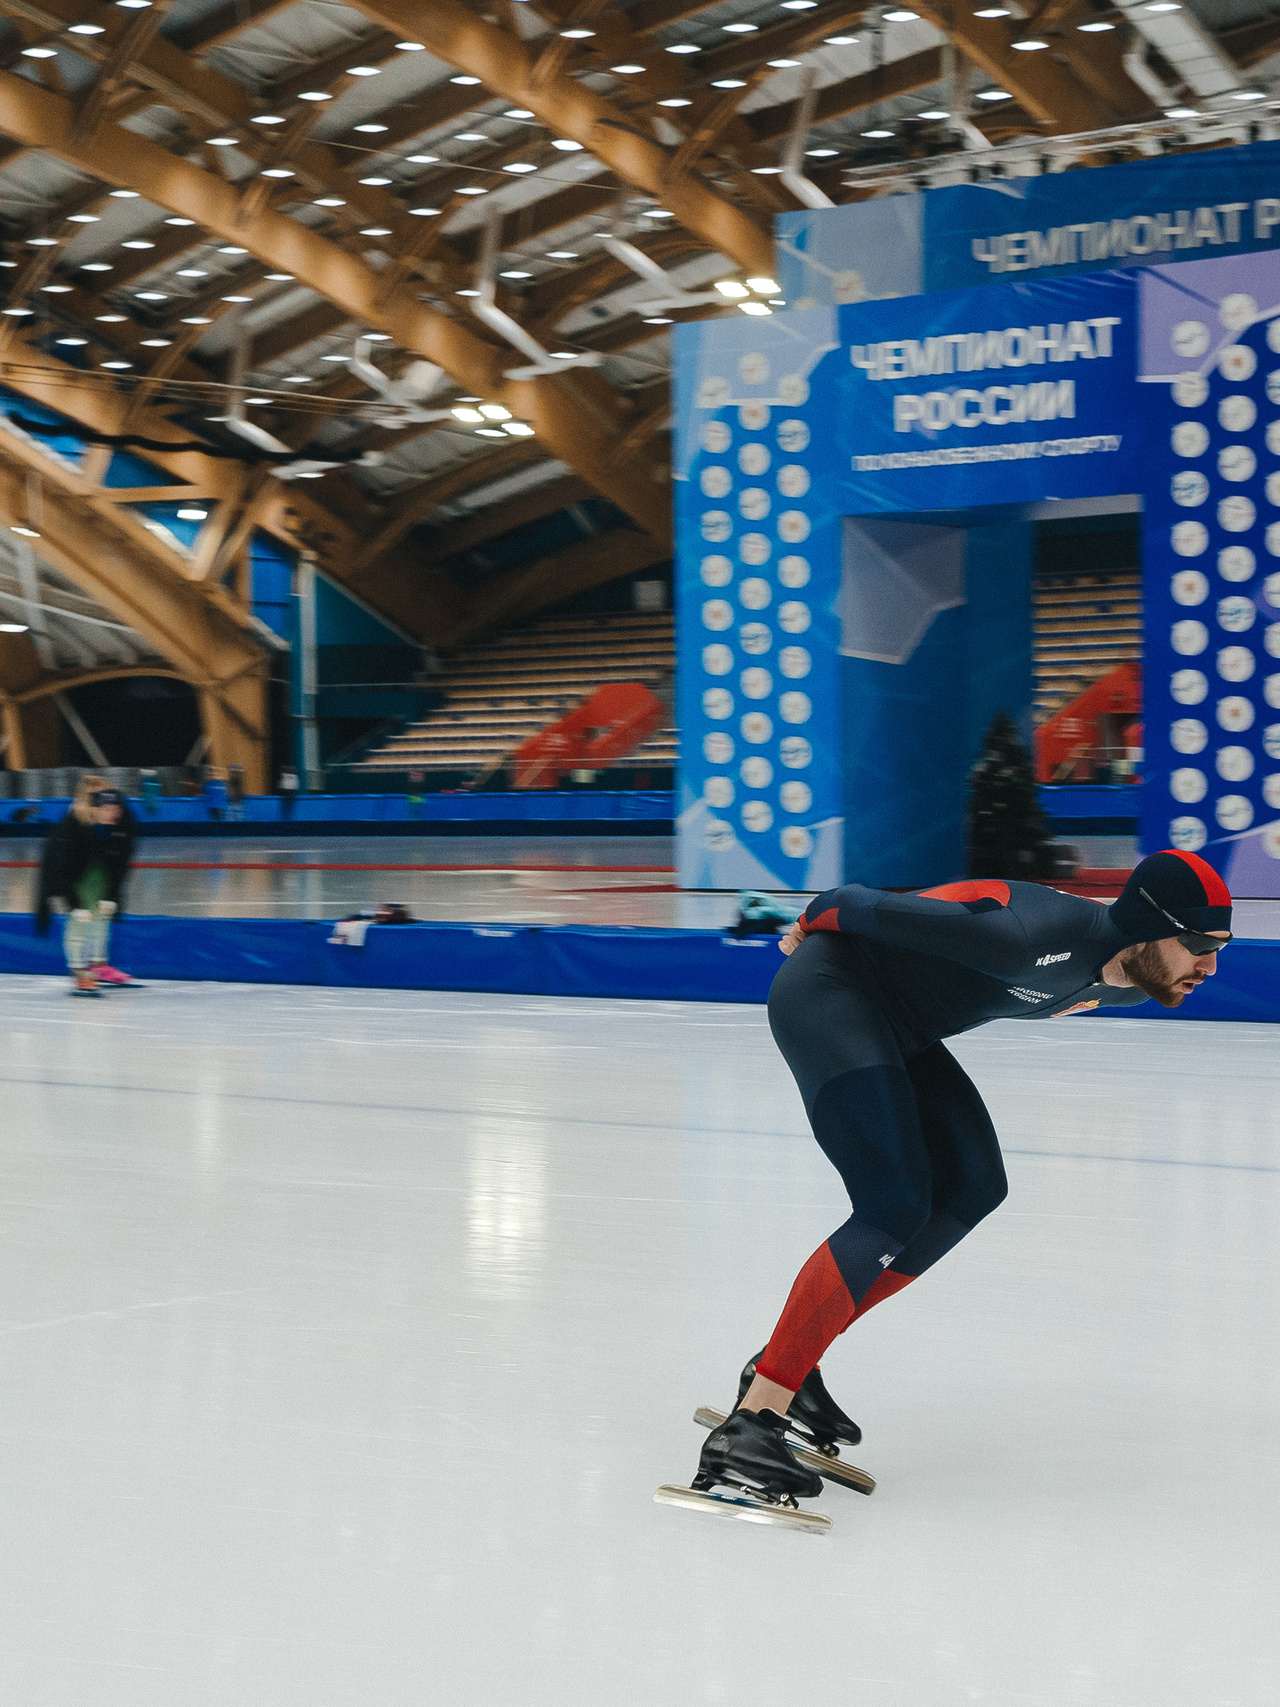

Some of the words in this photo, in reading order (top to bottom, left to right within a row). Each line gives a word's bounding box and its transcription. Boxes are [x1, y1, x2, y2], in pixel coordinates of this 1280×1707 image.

[972, 202, 1250, 273] ЧЕМПИОНАТ
[851, 317, 1121, 380] ЧЕМПИОНАТ
[893, 379, 1075, 433] РОССИИ
